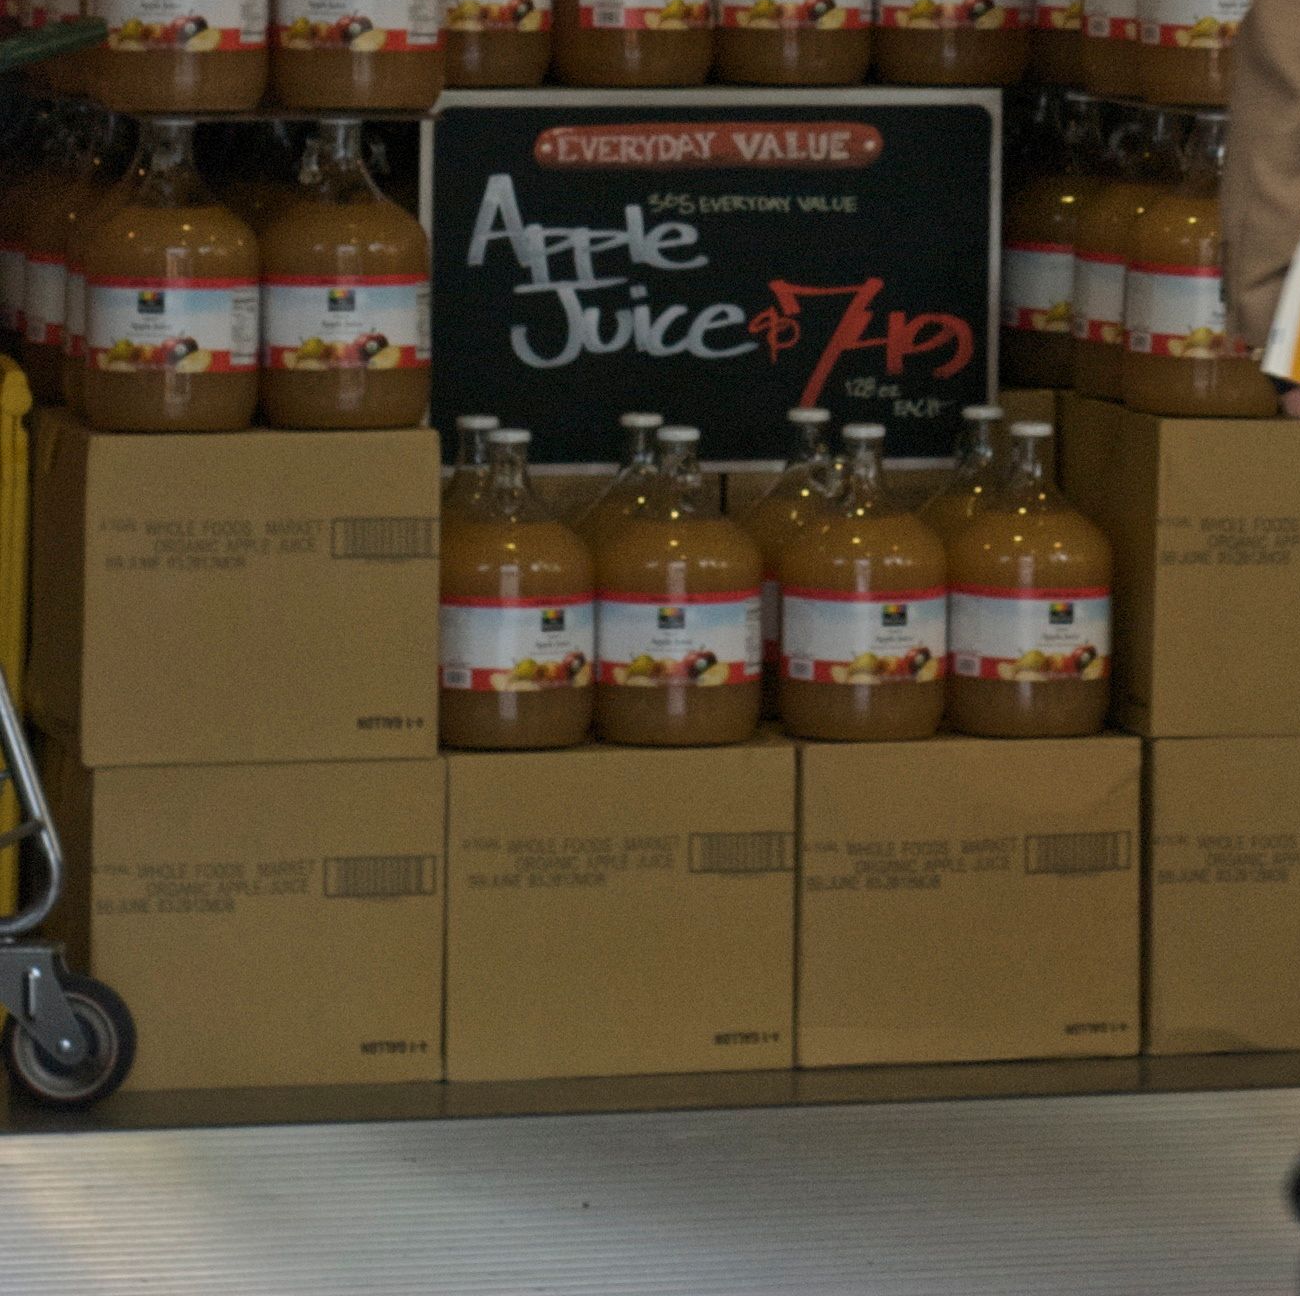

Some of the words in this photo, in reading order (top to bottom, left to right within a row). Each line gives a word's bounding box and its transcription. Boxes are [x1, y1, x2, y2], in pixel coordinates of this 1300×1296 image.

[557, 130, 716, 163] EVERYDAY
[732, 131, 851, 161] VALUE
[468, 173, 709, 283] Apple
[510, 276, 758, 369] Juice
